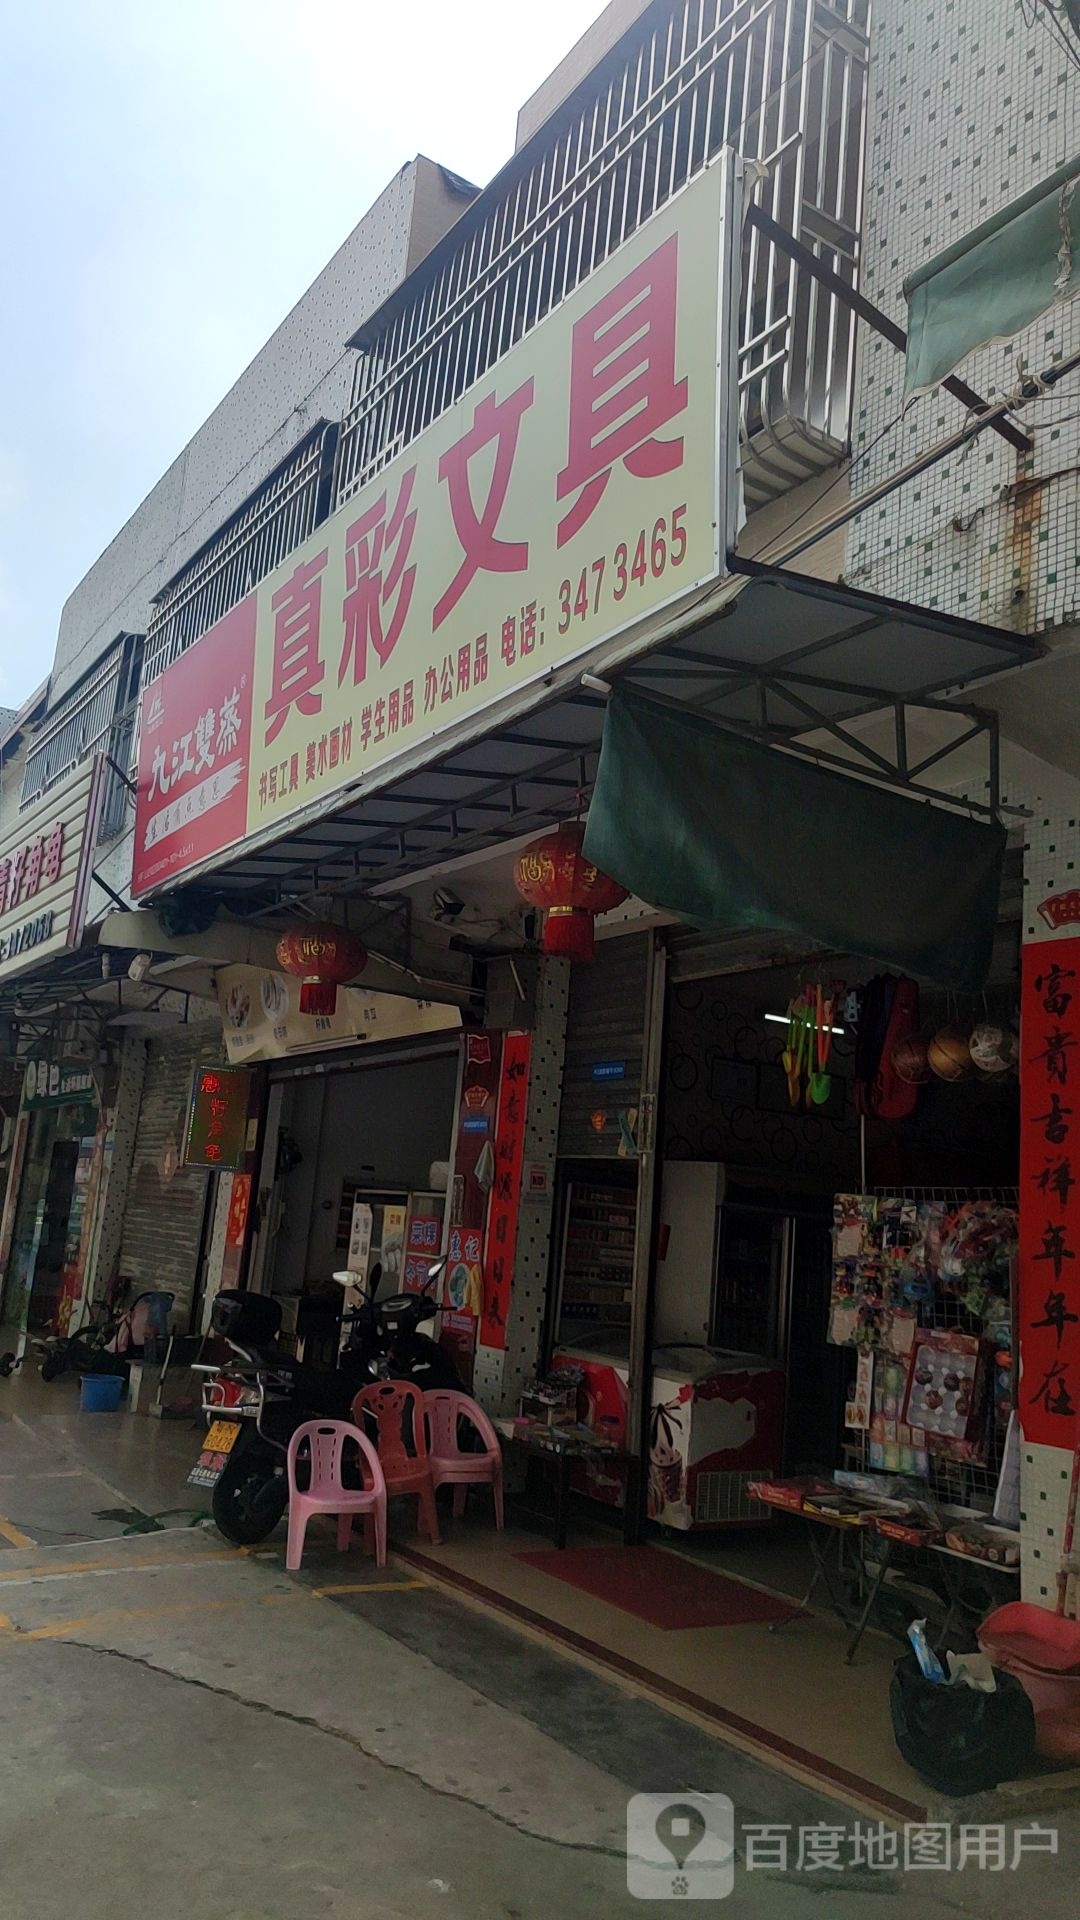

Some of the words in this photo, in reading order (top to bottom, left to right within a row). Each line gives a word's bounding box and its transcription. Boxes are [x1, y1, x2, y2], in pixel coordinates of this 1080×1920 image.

[264, 233, 688, 746] 真彩文具
[148, 686, 243, 803] 九江雙蒸
[258, 751, 301, 811] 书写工具
[305, 716, 353, 785] 美术画材
[360, 680, 415, 754] 学生用品
[423, 632, 489, 715] 办公用品
